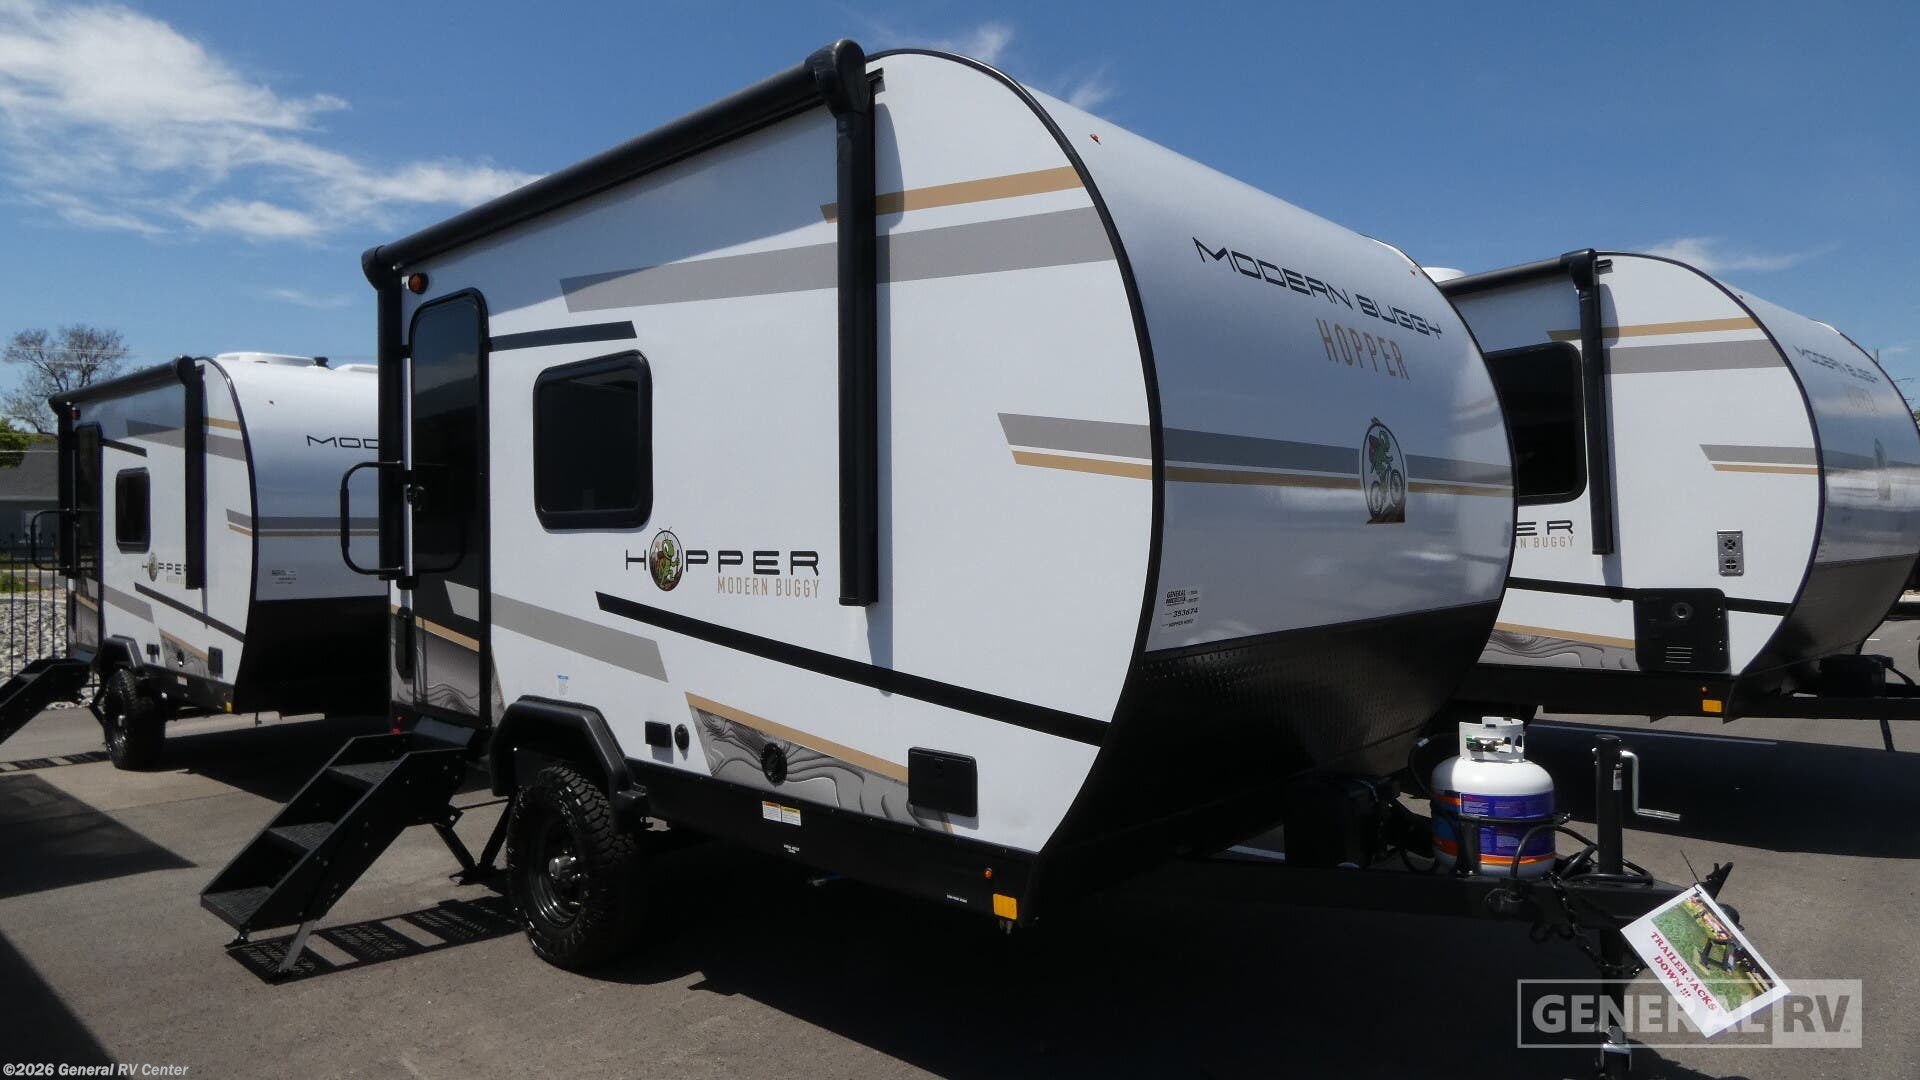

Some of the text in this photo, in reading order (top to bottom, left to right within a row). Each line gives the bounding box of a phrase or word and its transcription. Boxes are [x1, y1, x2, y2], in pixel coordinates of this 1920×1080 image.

[1192, 236, 1442, 340] MODERN BUGGY
[1316, 318, 1410, 381] HOPPER
[1534, 535, 1575, 549] BUGGY
[717, 576, 820, 599] MODERN BUGGY
[1650, 931, 1718, 1012] TRAILER JACKS
[1653, 955, 1682, 988] DOWN
